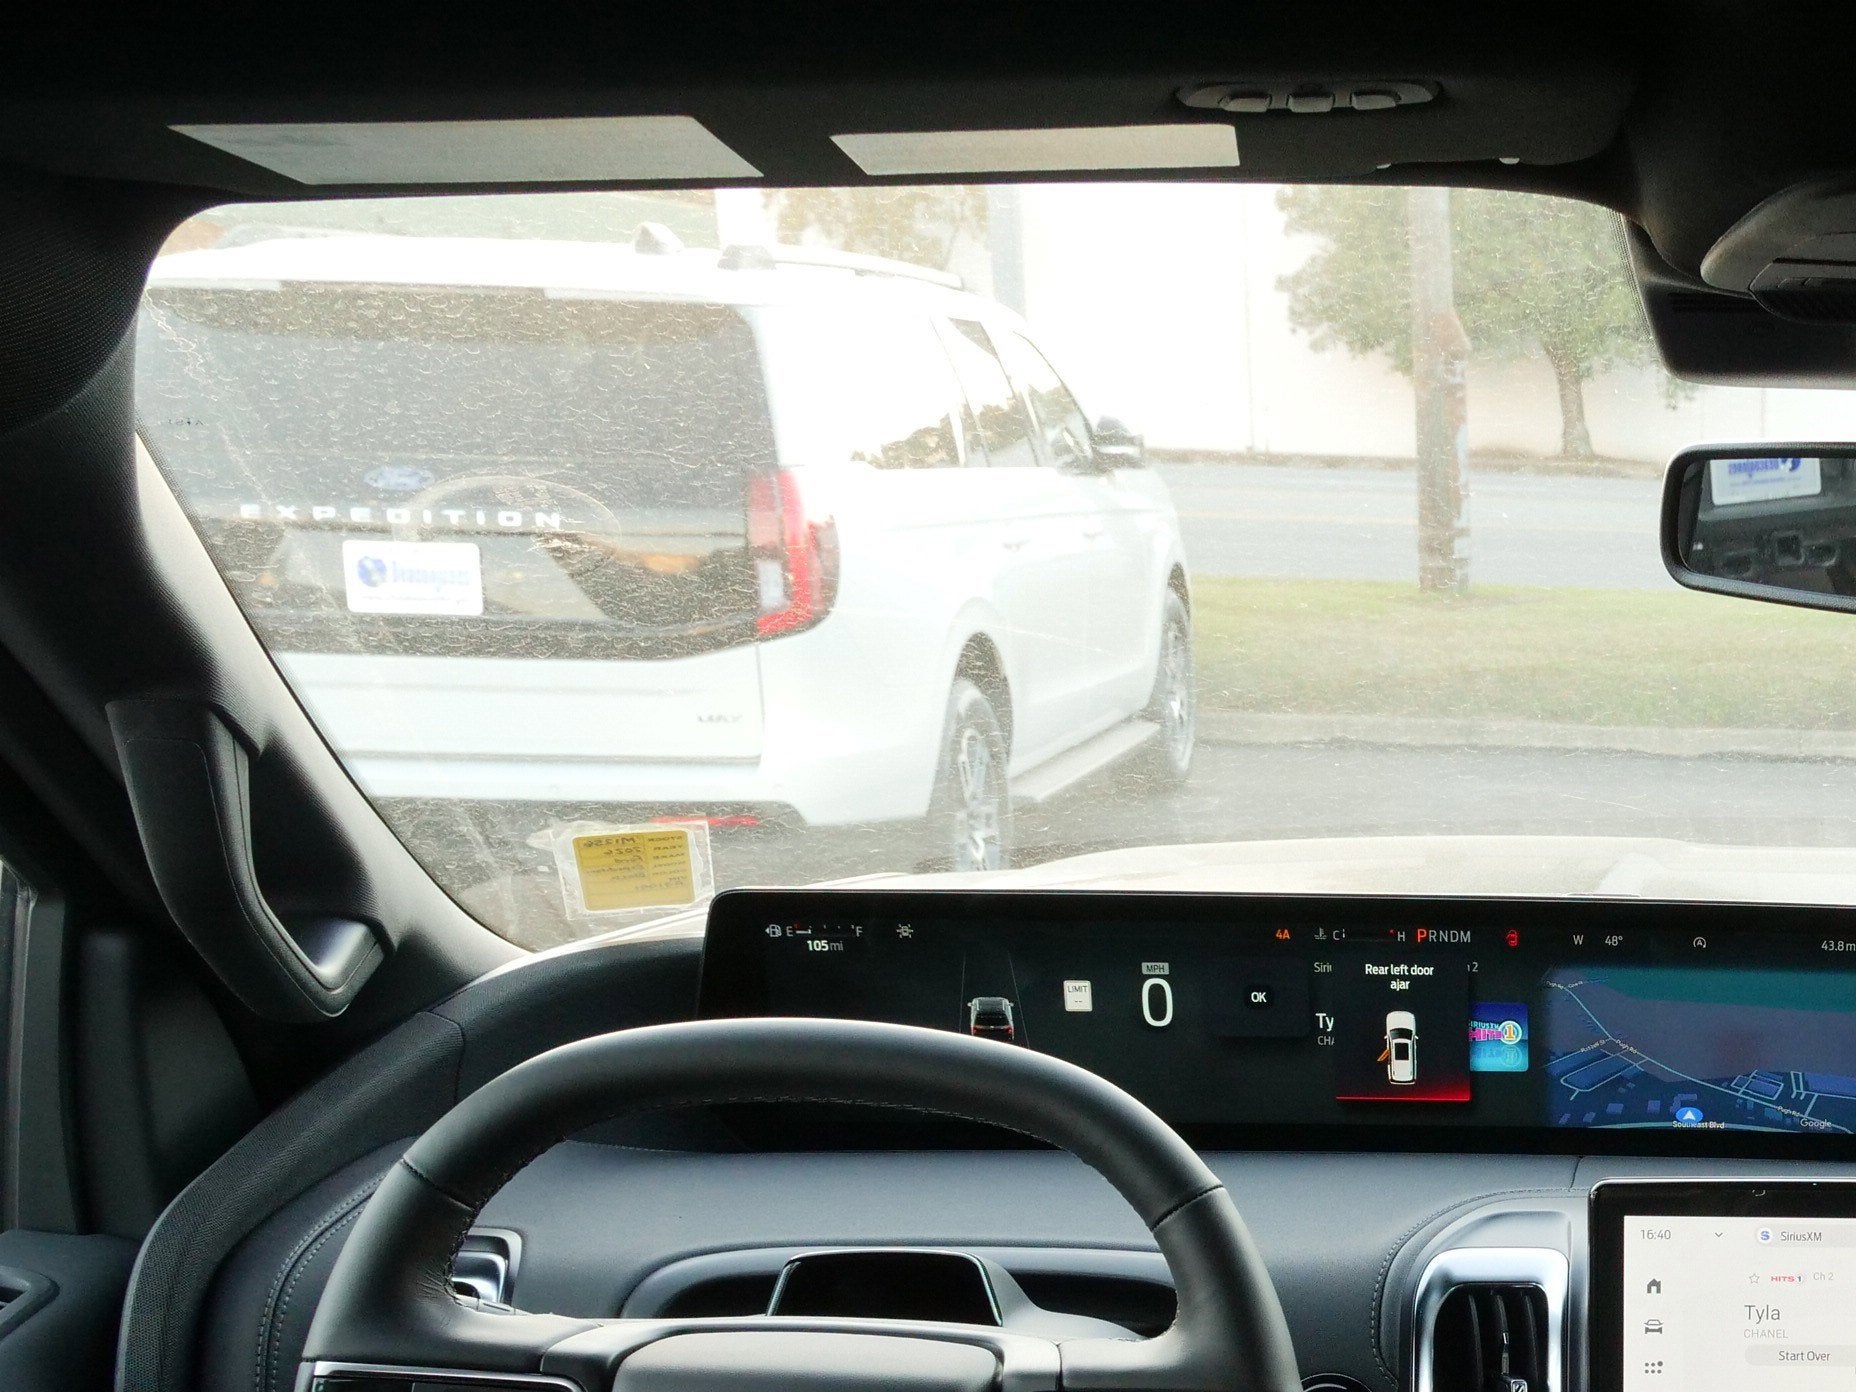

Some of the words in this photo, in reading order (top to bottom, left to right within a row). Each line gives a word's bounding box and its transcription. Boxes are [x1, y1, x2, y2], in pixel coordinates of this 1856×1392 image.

[240, 503, 560, 529] EXPEDITION
[786, 926, 794, 937] E
[1275, 929, 1291, 940] 4A
[1397, 931, 1406, 942] H
[806, 940, 829, 951] 105
[830, 941, 844, 951] mi
[1573, 935, 1584, 946] W
[1605, 935, 1624, 946] 48°
[1821, 940, 1844, 952] 43.8
[1146, 964, 1165, 973] MPH
[1365, 964, 1388, 975] Rear
[1390, 963, 1408, 975] left
[1410, 964, 1434, 976] door
[1067, 985, 1088, 994] LIMIT
[1390, 979, 1410, 991] ajar
[1141, 977, 1173, 1027] 0
[1251, 991, 1266, 1003] OK
[1709, 1120, 1725, 1129] Blvd
[1800, 1118, 1832, 1130] Google
[1640, 1229, 1671, 1240] 16:40
[1780, 1231, 1822, 1242] SiriusXM
[1813, 1272, 1825, 1281] Ch
[1827, 1272, 1834, 1281] 2
[1744, 1304, 1780, 1324] Tyla
[1743, 1329, 1789, 1339] CHANEL
[1778, 1351, 1804, 1361] Start
[1806, 1351, 1831, 1361] Over
